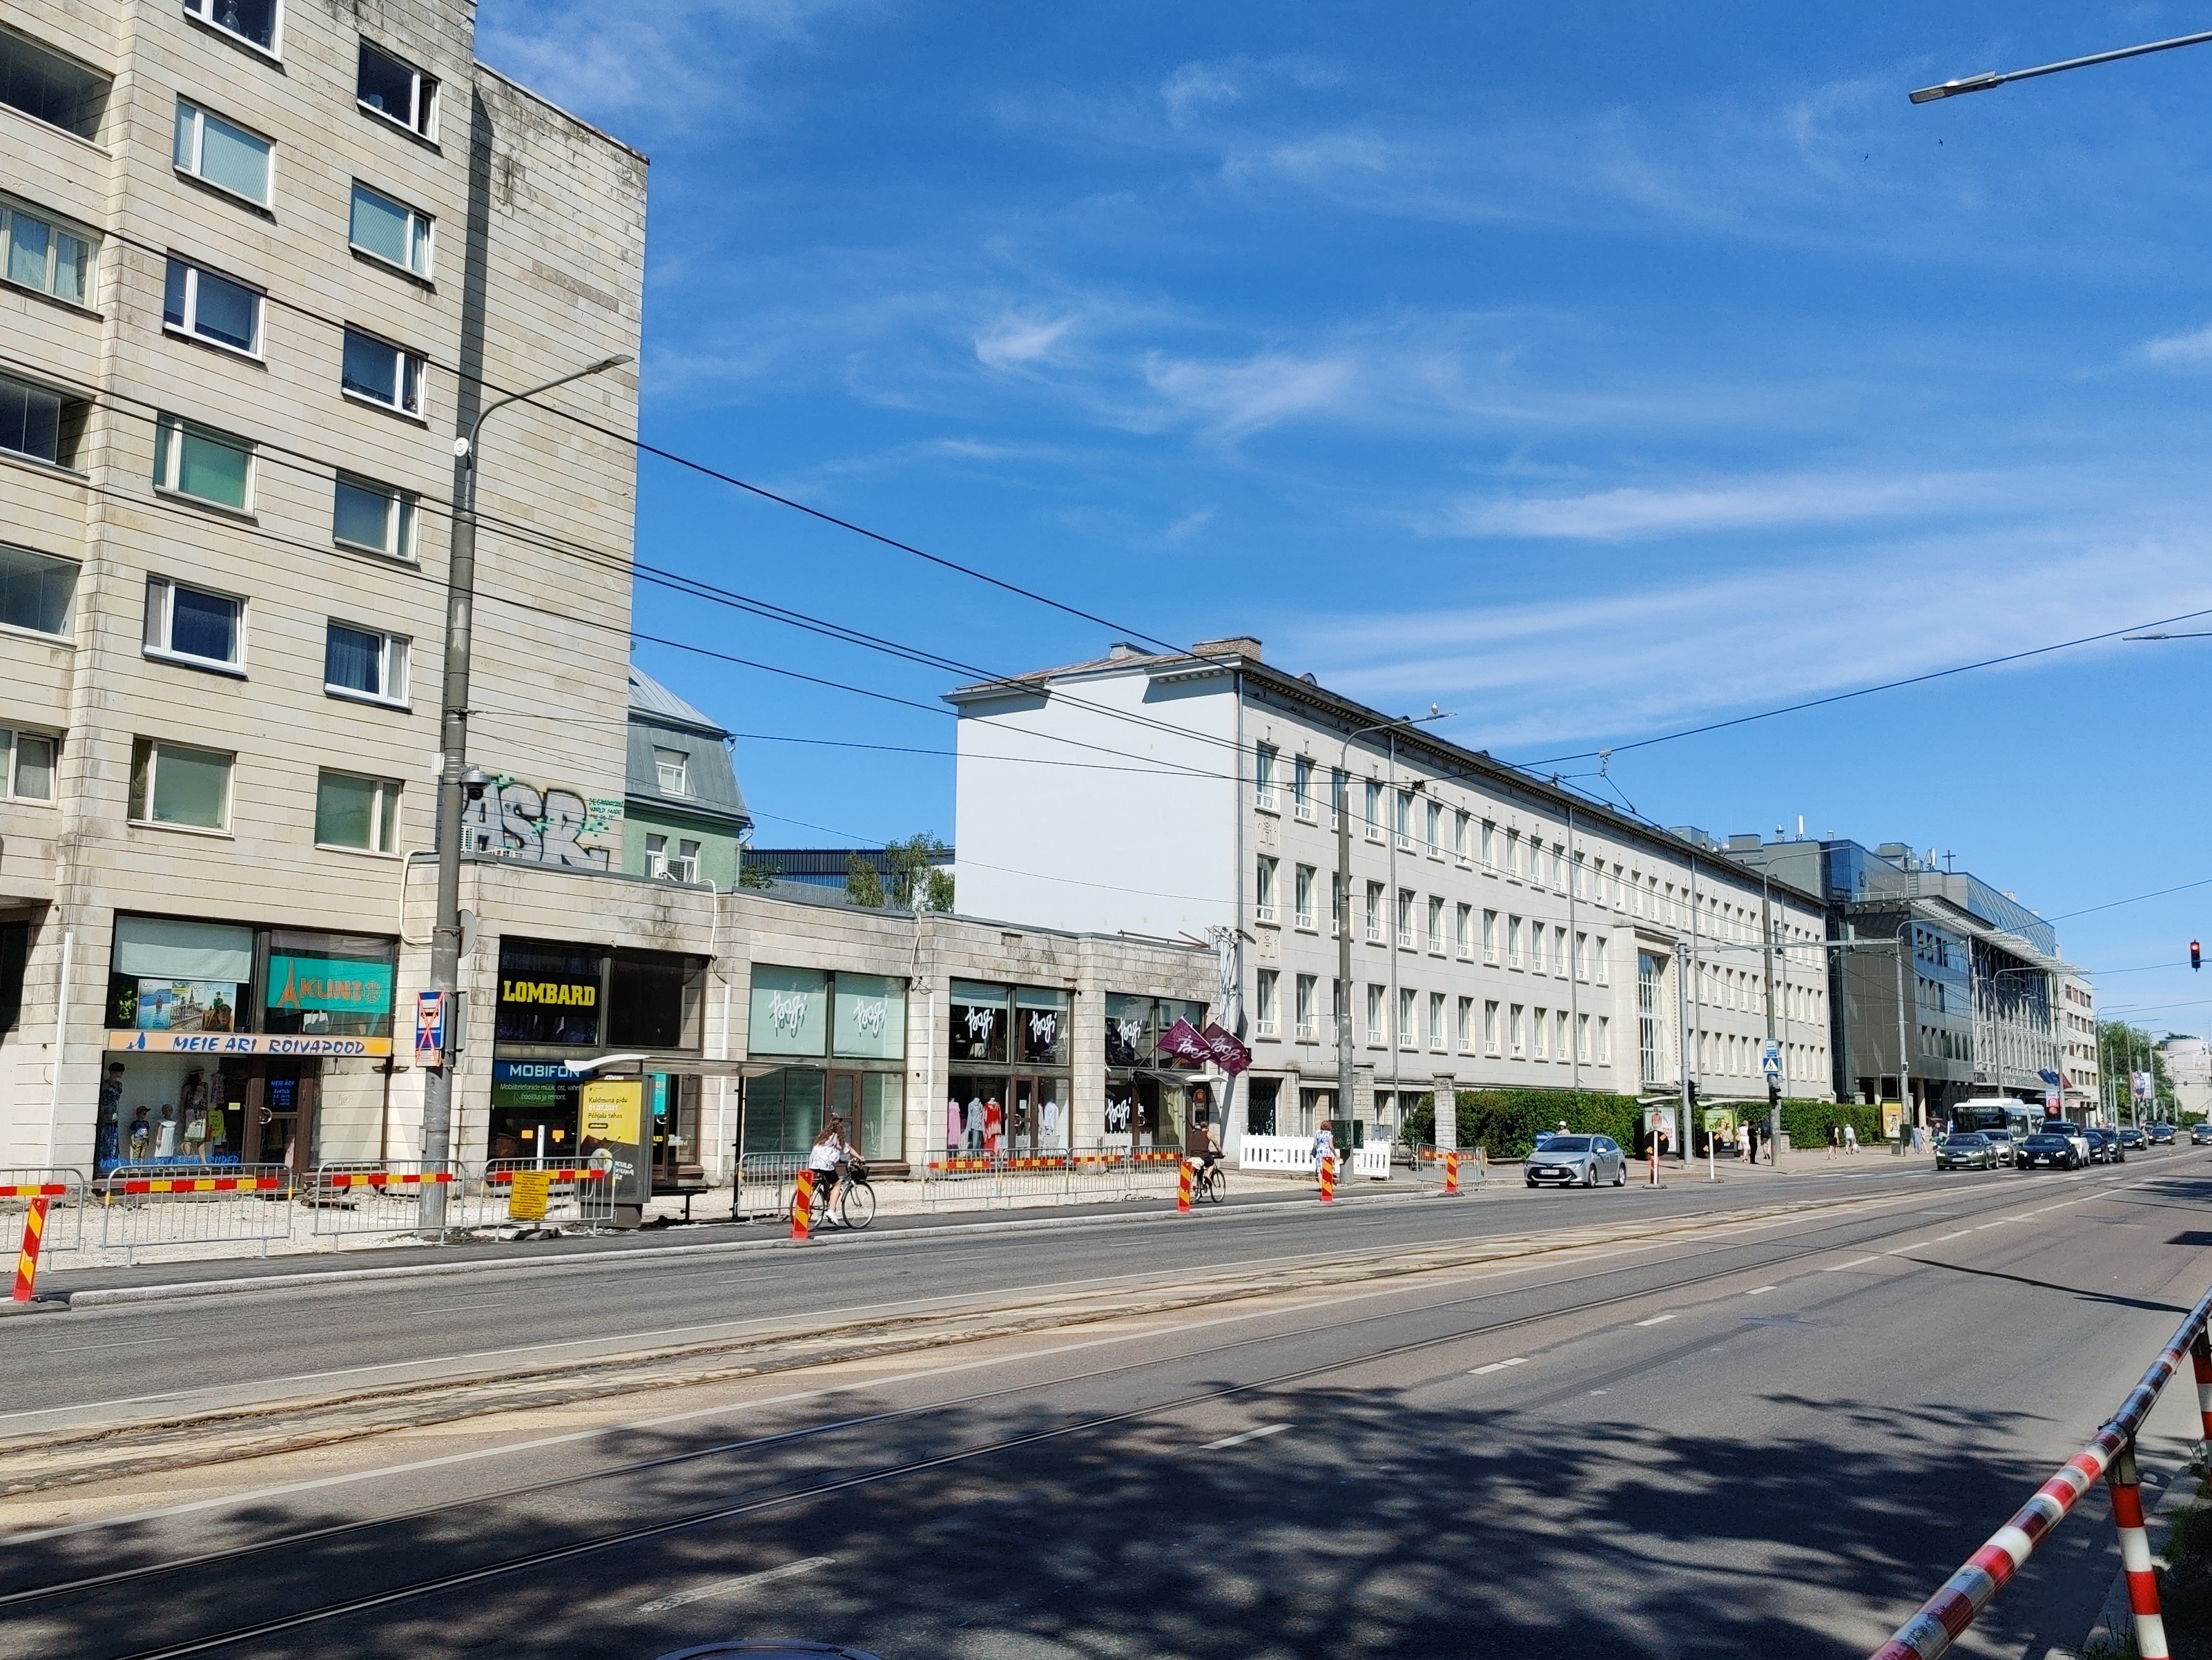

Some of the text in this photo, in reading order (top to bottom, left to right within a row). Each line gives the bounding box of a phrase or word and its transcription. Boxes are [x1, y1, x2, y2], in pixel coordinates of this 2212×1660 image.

[503, 980, 596, 1006] LOMBARD
[173, 1033, 365, 1054] MEIE ÄRI RÕIVAPOOD
[616, 1097, 628, 1106] pidu
[614, 1160, 634, 1170] KULD
